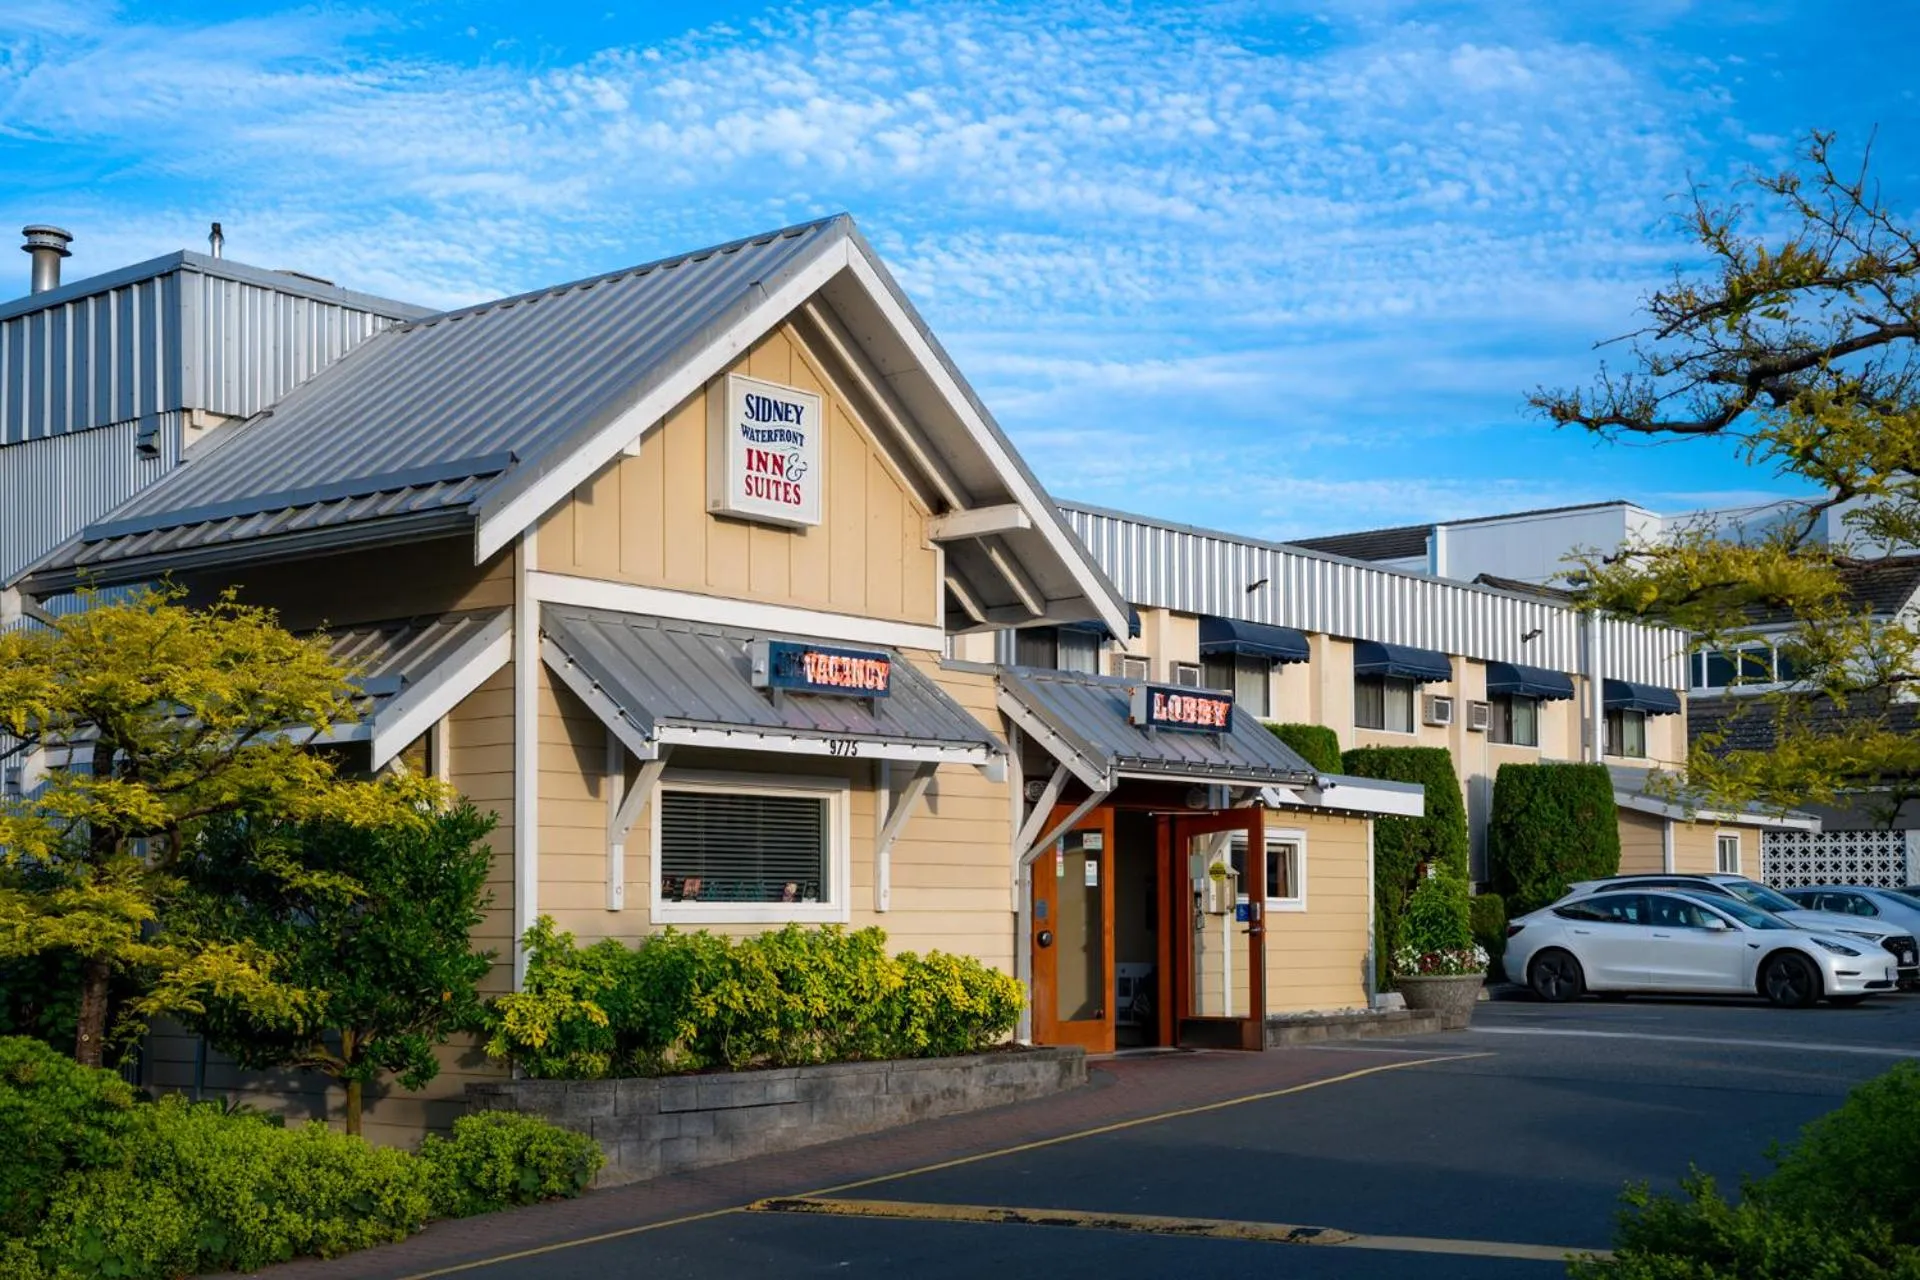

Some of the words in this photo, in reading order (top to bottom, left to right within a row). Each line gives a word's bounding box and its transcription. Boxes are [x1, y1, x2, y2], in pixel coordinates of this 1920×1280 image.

[744, 393, 805, 426] SIDNEY
[740, 423, 805, 447] WATERFRONT
[746, 447, 785, 478] INN
[786, 452, 808, 482] &
[744, 474, 801, 505] SUITES
[804, 651, 889, 691] VACANCY
[1153, 692, 1230, 727] LOBBY
[829, 739, 858, 757] 9775
